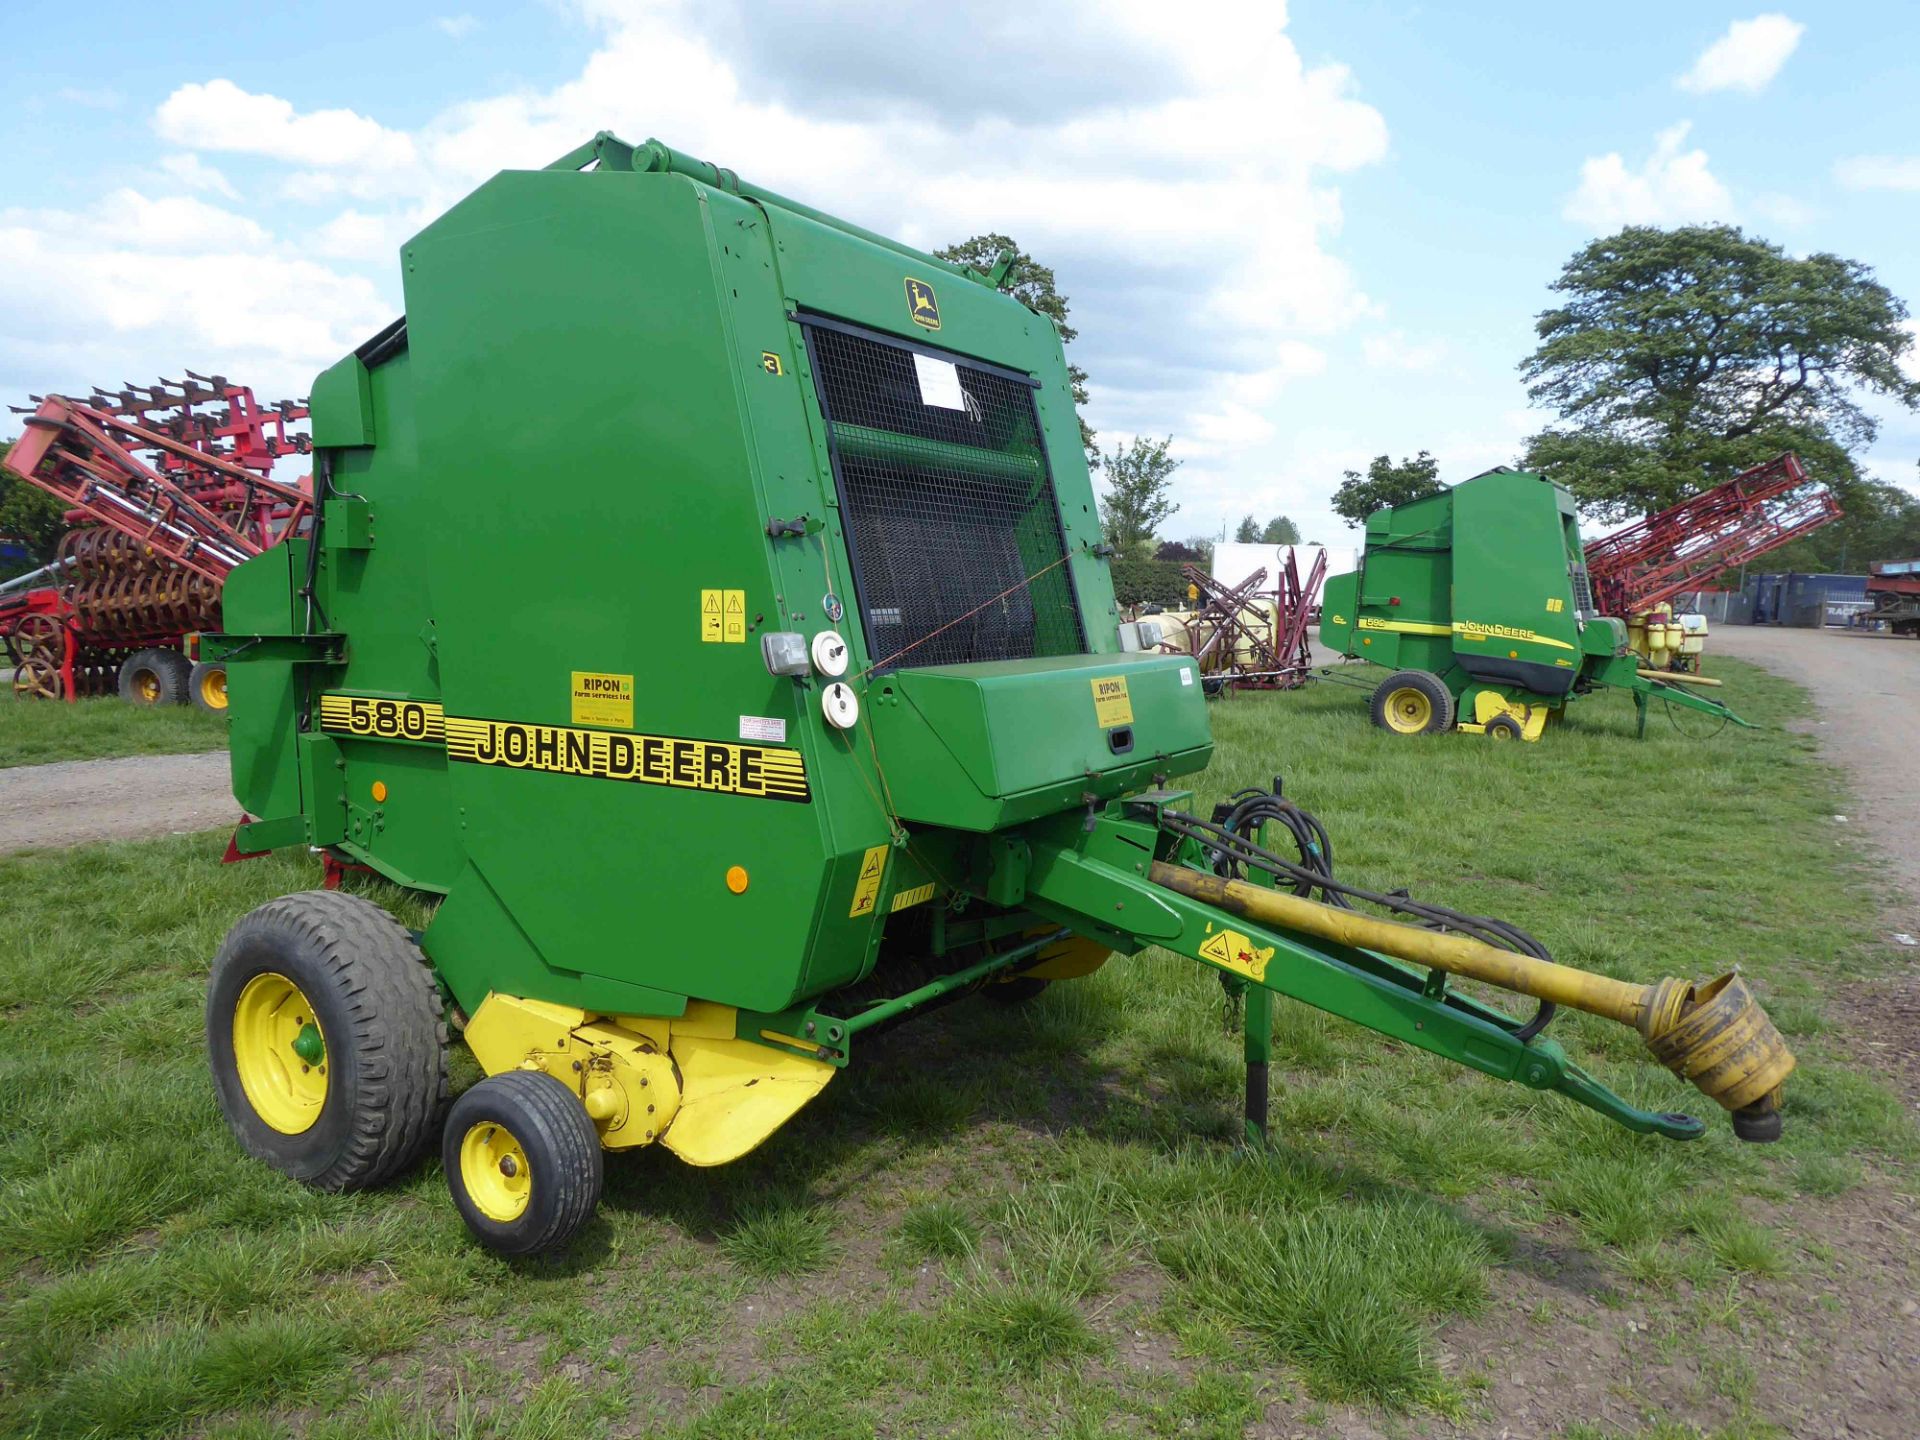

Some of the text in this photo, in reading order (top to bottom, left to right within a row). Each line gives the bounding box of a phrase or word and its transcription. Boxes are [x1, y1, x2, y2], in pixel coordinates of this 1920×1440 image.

[1366, 618, 1385, 628] 592
[1460, 619, 1495, 634] JOHN
[1493, 624, 1536, 639] DEERE
[583, 678, 620, 692] RIPON
[1098, 682, 1121, 695] RIPON
[574, 690, 591, 698] farm
[591, 692, 618, 700] services
[350, 699, 426, 738] 580
[477, 723, 766, 794] JOHN DEERE
